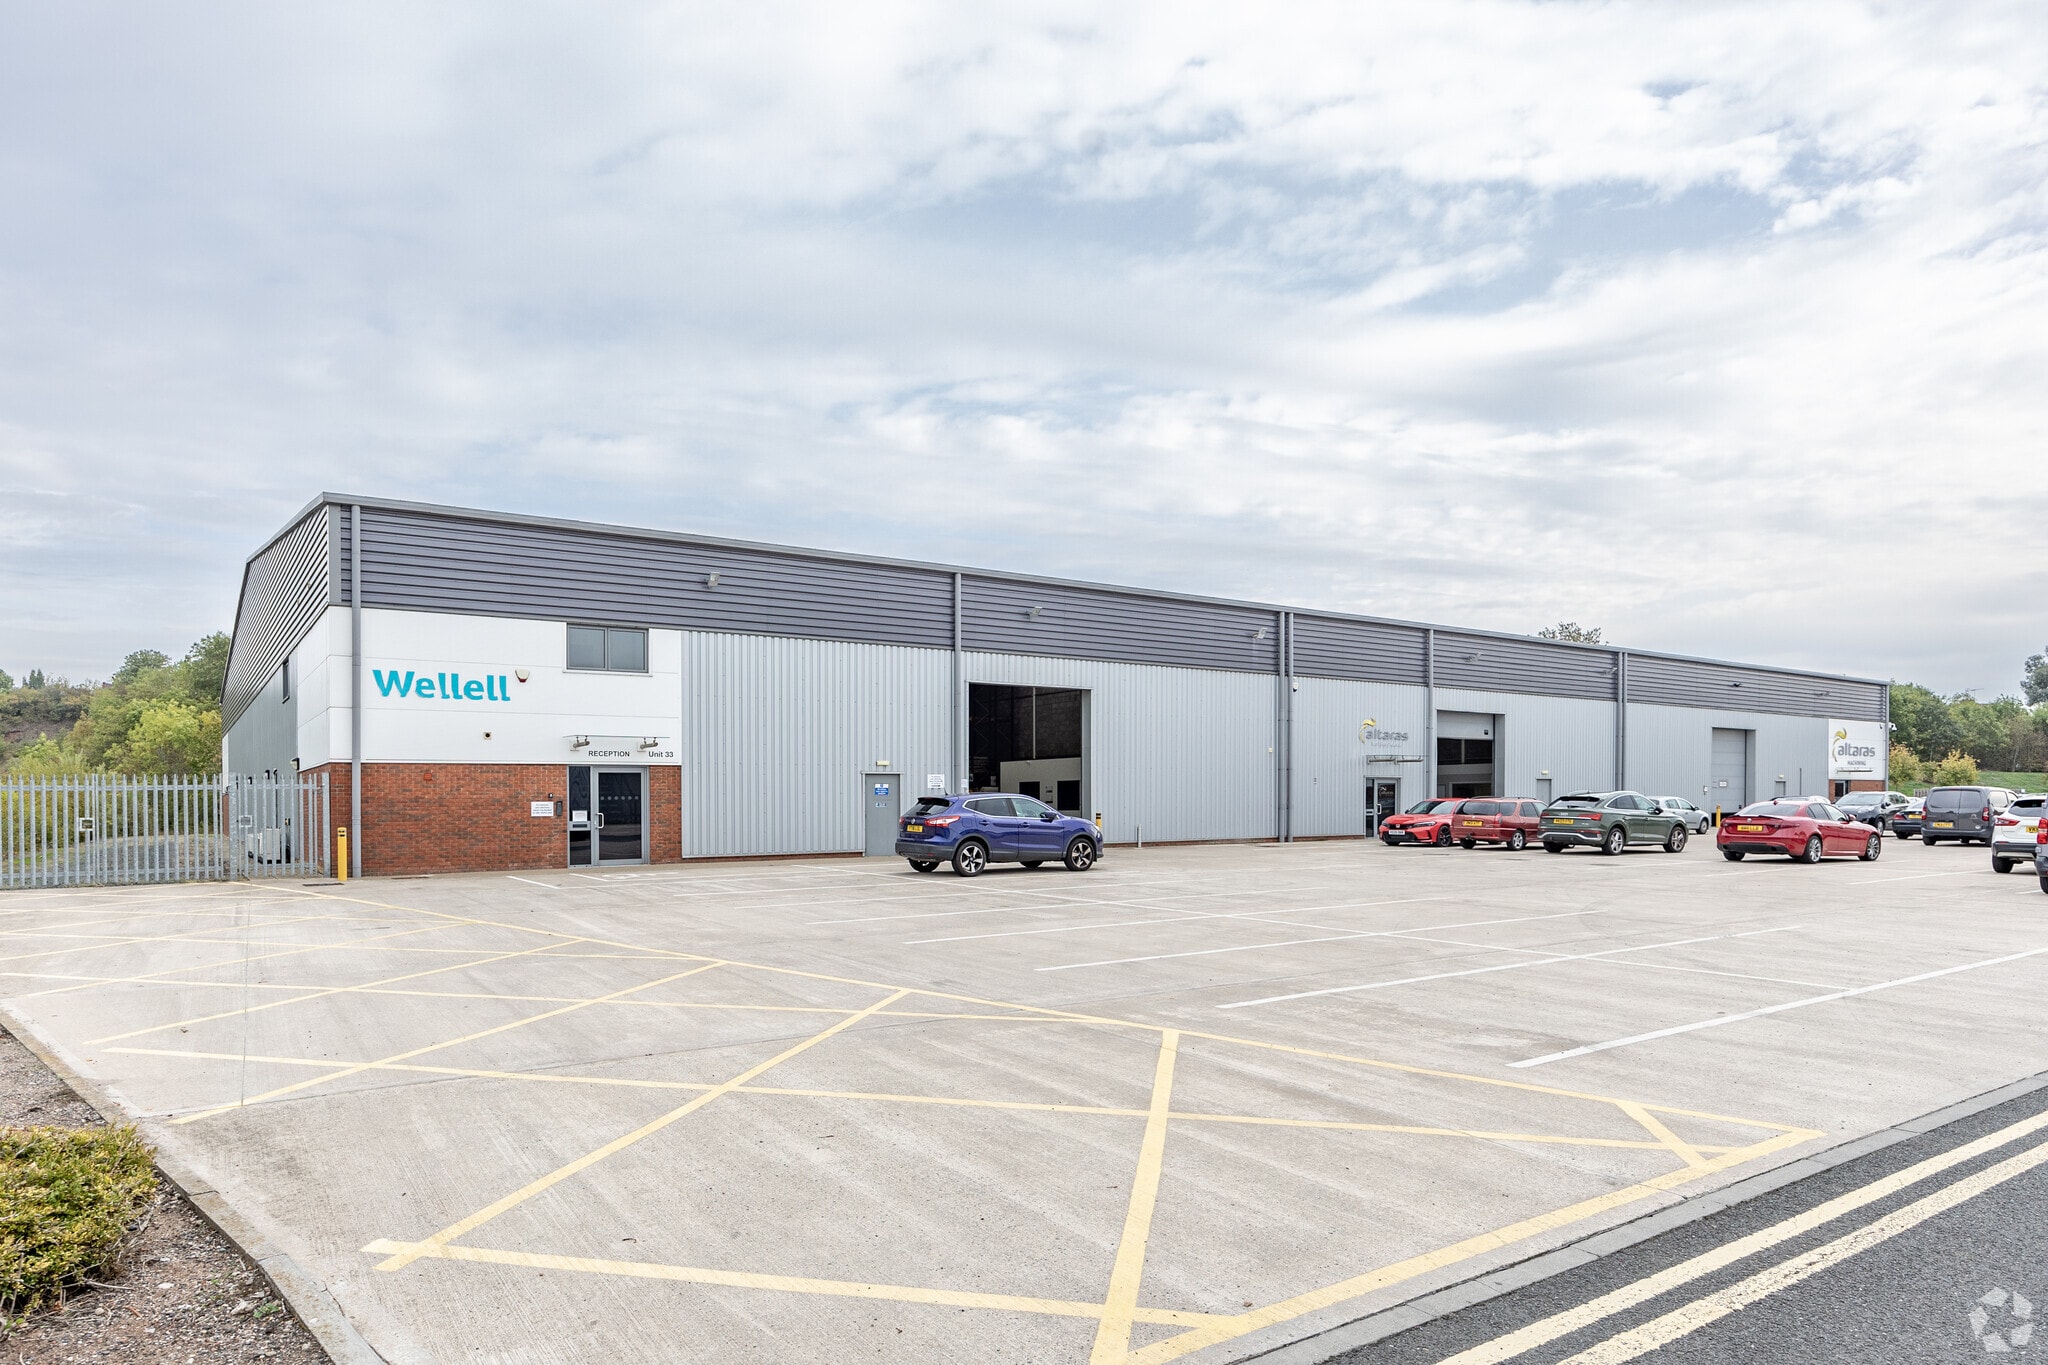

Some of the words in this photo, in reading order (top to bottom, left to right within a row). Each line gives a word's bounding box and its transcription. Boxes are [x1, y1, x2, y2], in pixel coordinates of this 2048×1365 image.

[372, 669, 511, 701] Wellell
[1365, 728, 1408, 741] altaras
[1837, 742, 1875, 757] altaras
